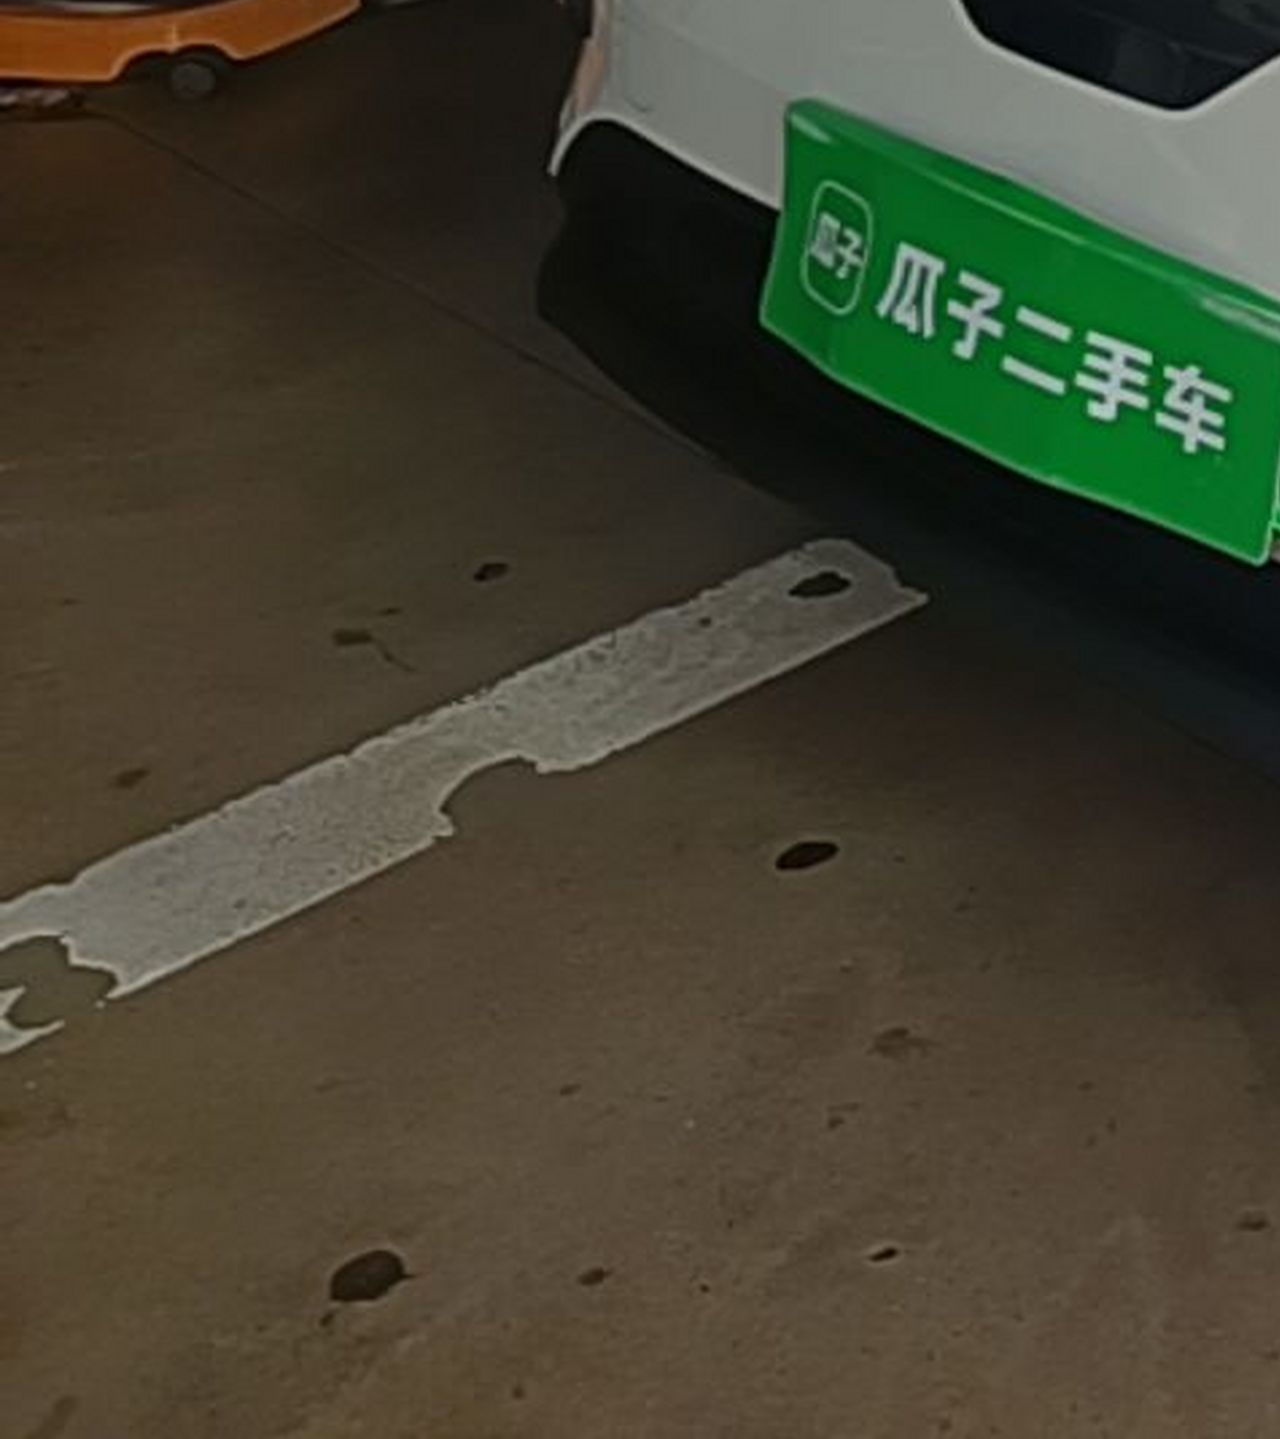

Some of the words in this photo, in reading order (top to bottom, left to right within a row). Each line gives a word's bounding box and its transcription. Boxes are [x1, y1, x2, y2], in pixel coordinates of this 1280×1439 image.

[877, 242, 1232, 453] 瓜子二手车
